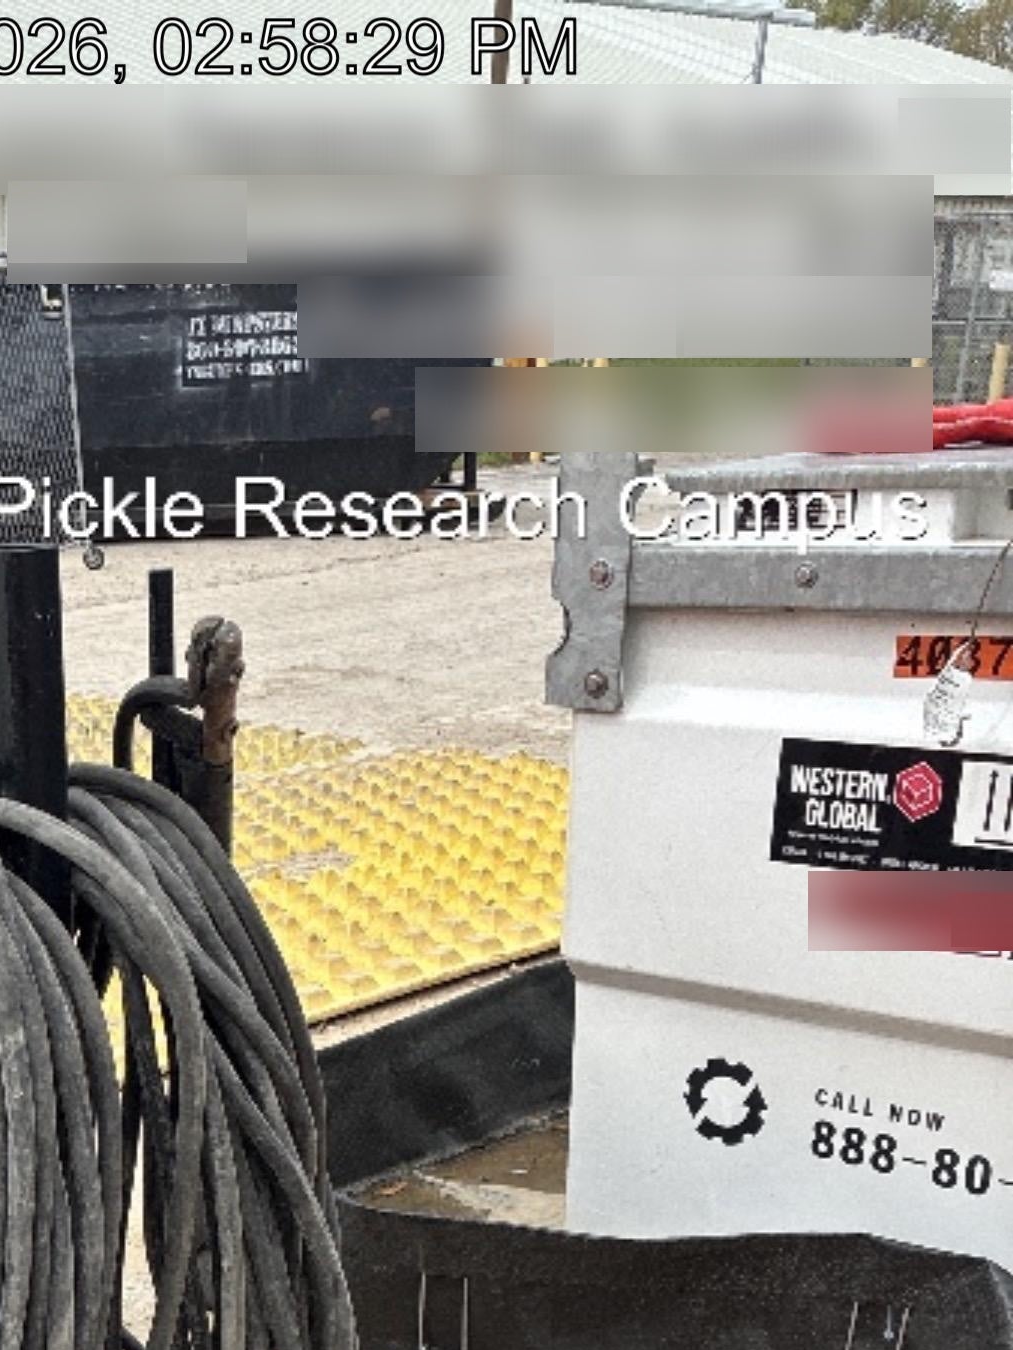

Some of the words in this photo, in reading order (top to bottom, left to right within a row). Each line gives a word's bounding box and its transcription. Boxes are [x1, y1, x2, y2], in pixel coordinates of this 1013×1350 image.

[790, 764, 889, 804] WESTERN
[804, 798, 882, 835] GLOBAL
[814, 1087, 874, 1117] CALL
[890, 1103, 945, 1132] NOW
